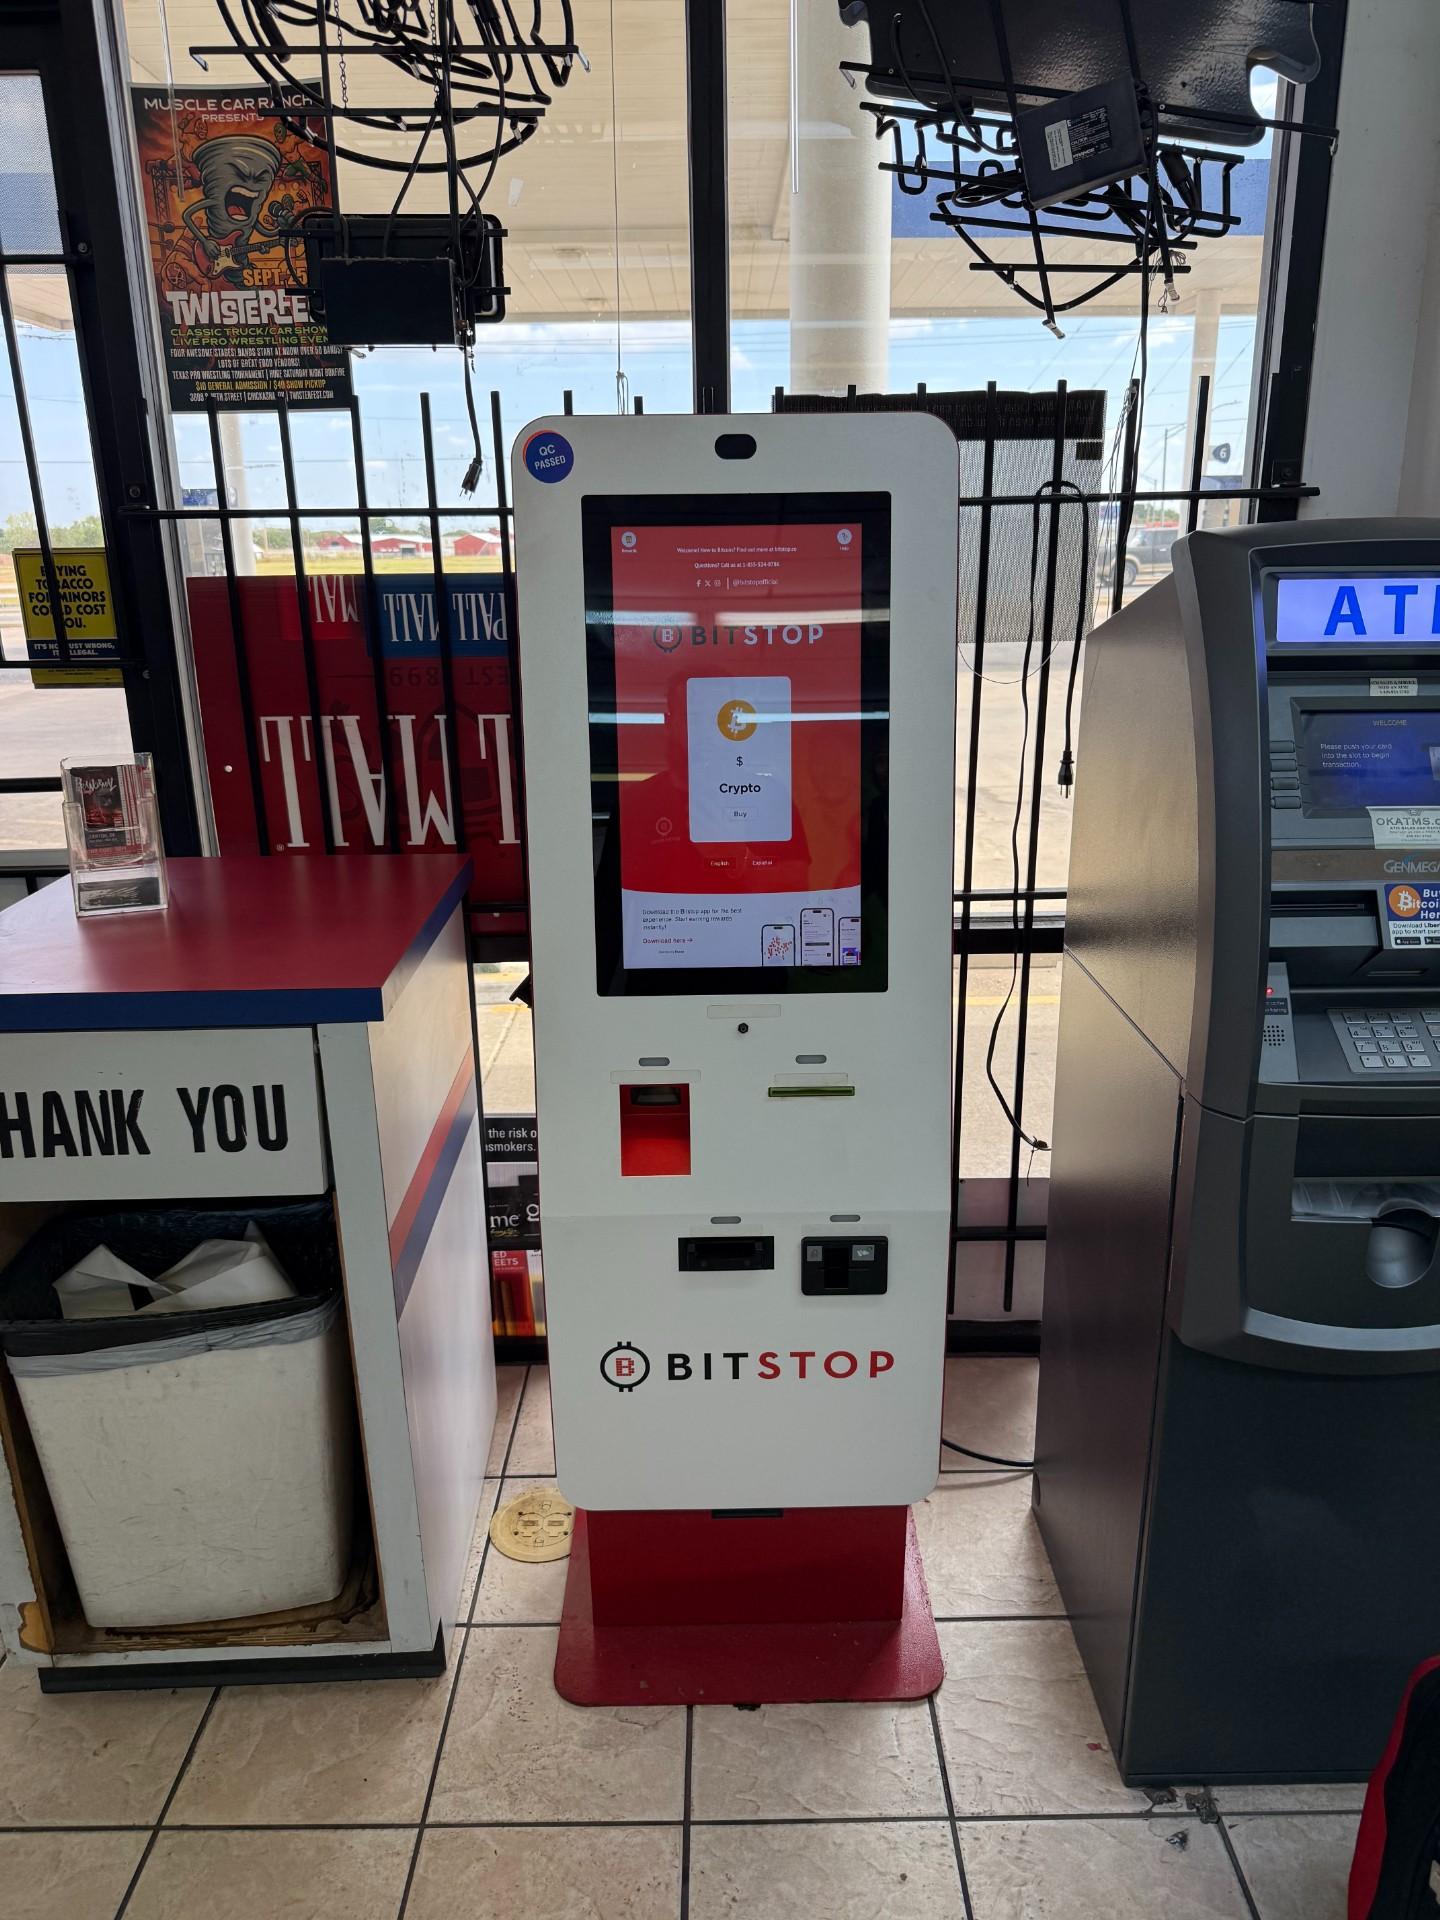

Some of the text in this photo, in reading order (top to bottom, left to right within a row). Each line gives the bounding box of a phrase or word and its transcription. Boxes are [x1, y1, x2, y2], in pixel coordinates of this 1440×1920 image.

[144, 98, 218, 111] MUSCLE
[221, 98, 257, 111] CAR
[242, 268, 283, 287] SEPT.
[166, 289, 316, 326] TWISTERFE
[170, 326, 328, 337] CLASSIC TRUCK/CAR SHOW
[173, 335, 329, 346] LIVE PRO WRESTLING EVEN
[539, 444, 556, 456] QC
[534, 455, 566, 470] PASSED
[35, 578, 94, 590] TOACCO
[60, 590, 106, 603] MINORS
[305, 574, 361, 623] MAL
[32, 604, 106, 616] COD COST
[64, 617, 87, 629] OU.
[691, 623, 824, 646] BITSTOP
[84, 642, 115, 650] WRONG,
[1343, 743, 1360, 751] push
[735, 755, 744, 768] $
[1371, 752, 1390, 760] begin
[719, 783, 762, 795] Crypto
[1376, 817, 1440, 826] OKATMS.C
[1420, 911, 1440, 919] Her
[0, 1084, 289, 1158] HANK YOU
[488, 1127, 537, 1138] the risk o
[667, 1350, 895, 1381] BITSTOP
